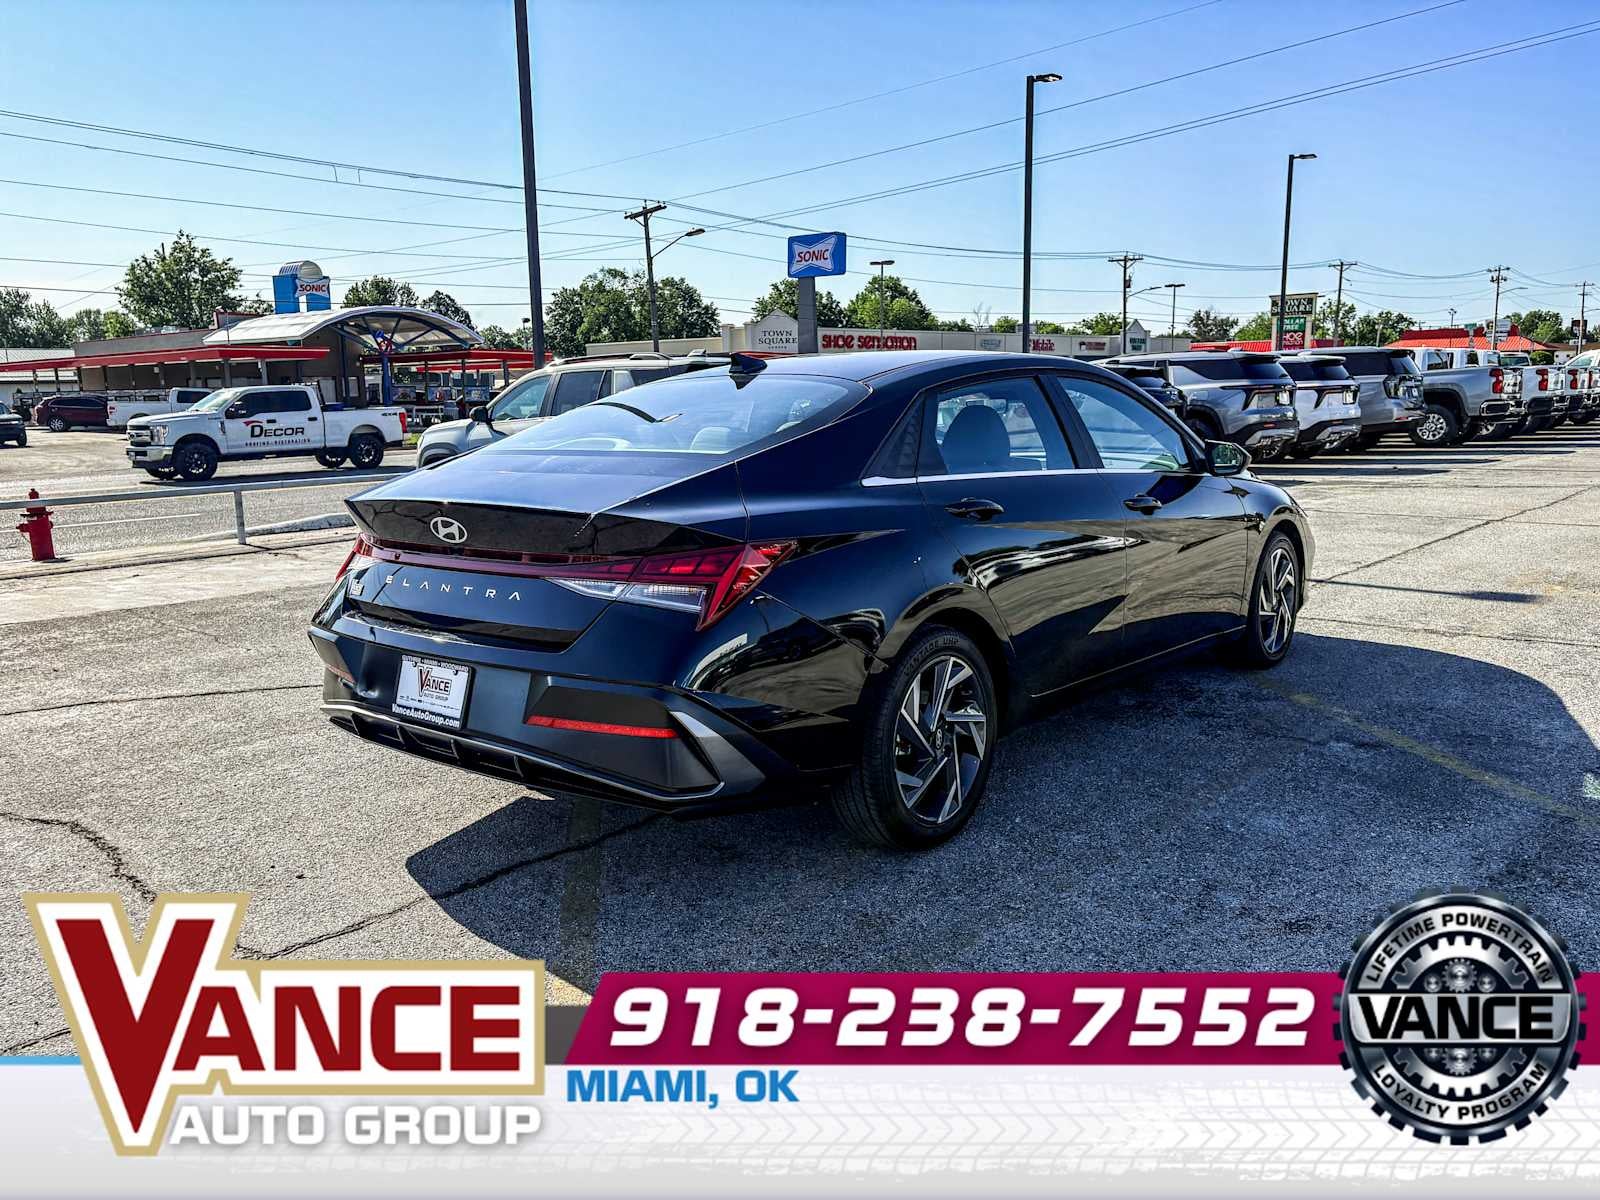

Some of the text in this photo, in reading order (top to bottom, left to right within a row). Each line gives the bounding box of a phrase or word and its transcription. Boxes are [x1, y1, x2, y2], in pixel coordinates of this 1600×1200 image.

[796, 249, 830, 263] SONIC
[299, 284, 327, 293] SONIC
[1271, 305, 1312, 313] SUARE
[758, 337, 798, 345] SQUARE
[761, 330, 793, 338] TOWN
[250, 424, 305, 438] DECOR
[385, 575, 522, 601] ELANTRA
[418, 666, 451, 694] VANCE
[392, 703, 460, 728] VanceAutoGroup.com
